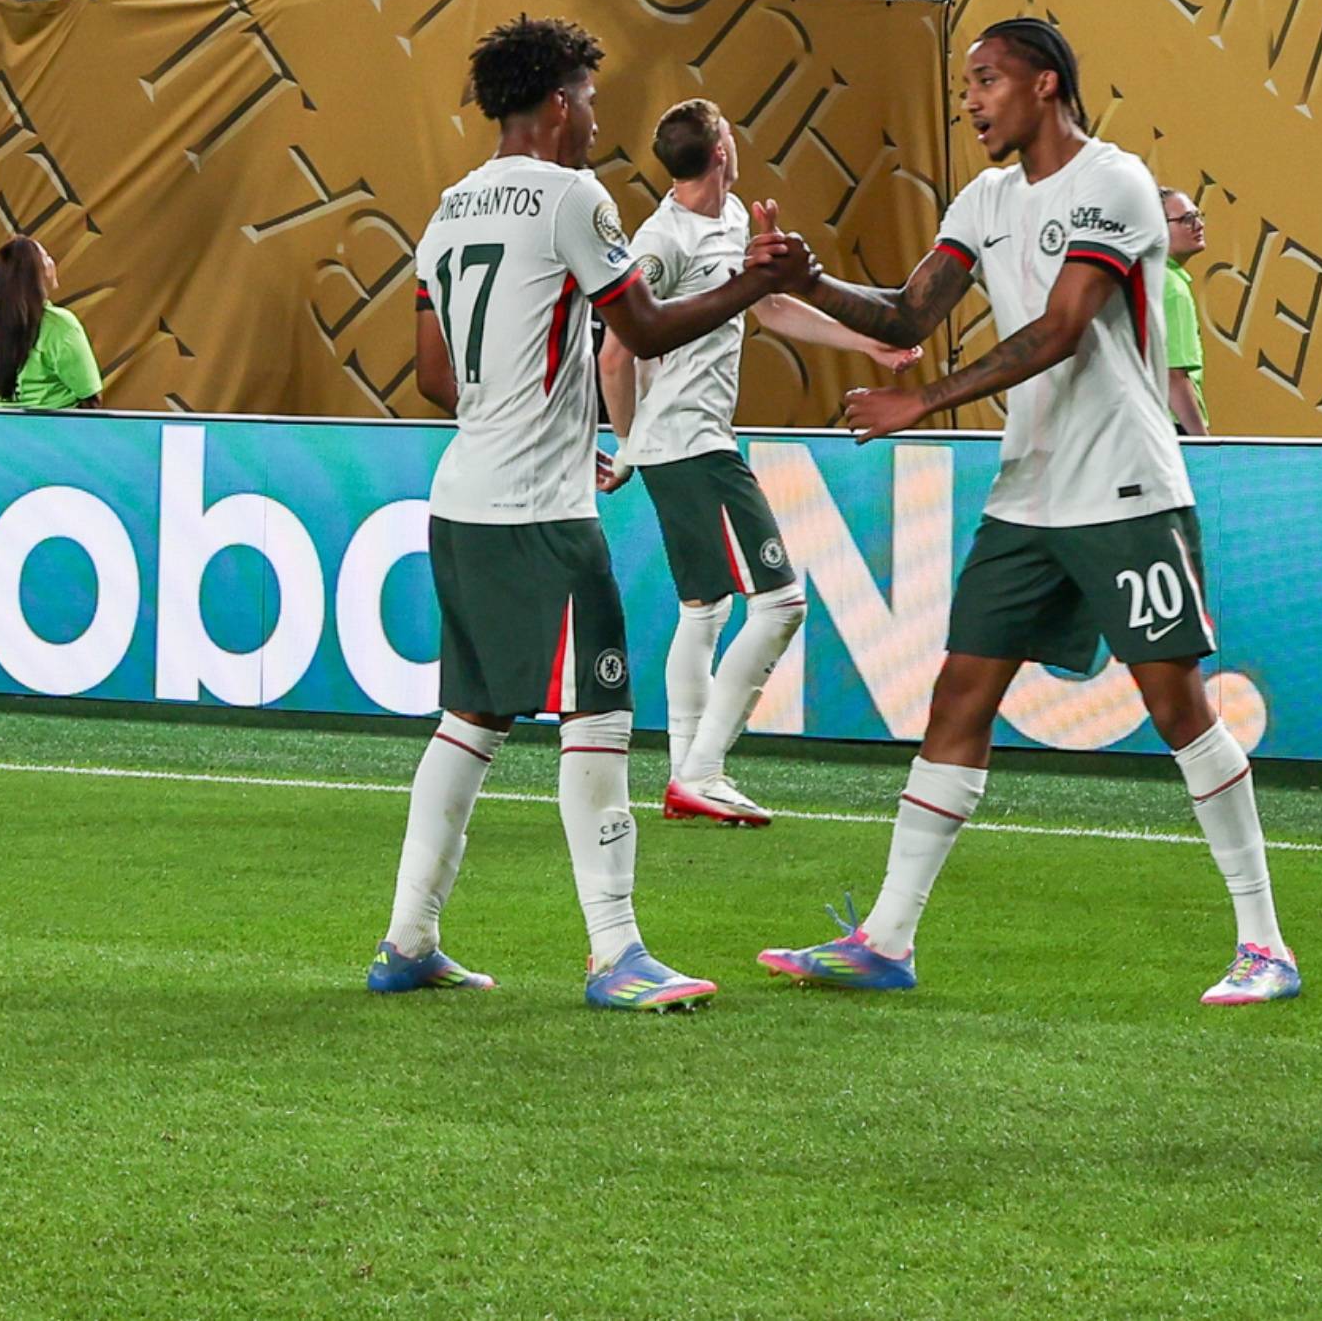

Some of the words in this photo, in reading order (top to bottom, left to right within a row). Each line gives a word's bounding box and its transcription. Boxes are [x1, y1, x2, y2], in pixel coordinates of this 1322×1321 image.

[473, 186, 543, 216] SANTOS
[435, 243, 506, 384] 17
[1116, 561, 1183, 628] 20
